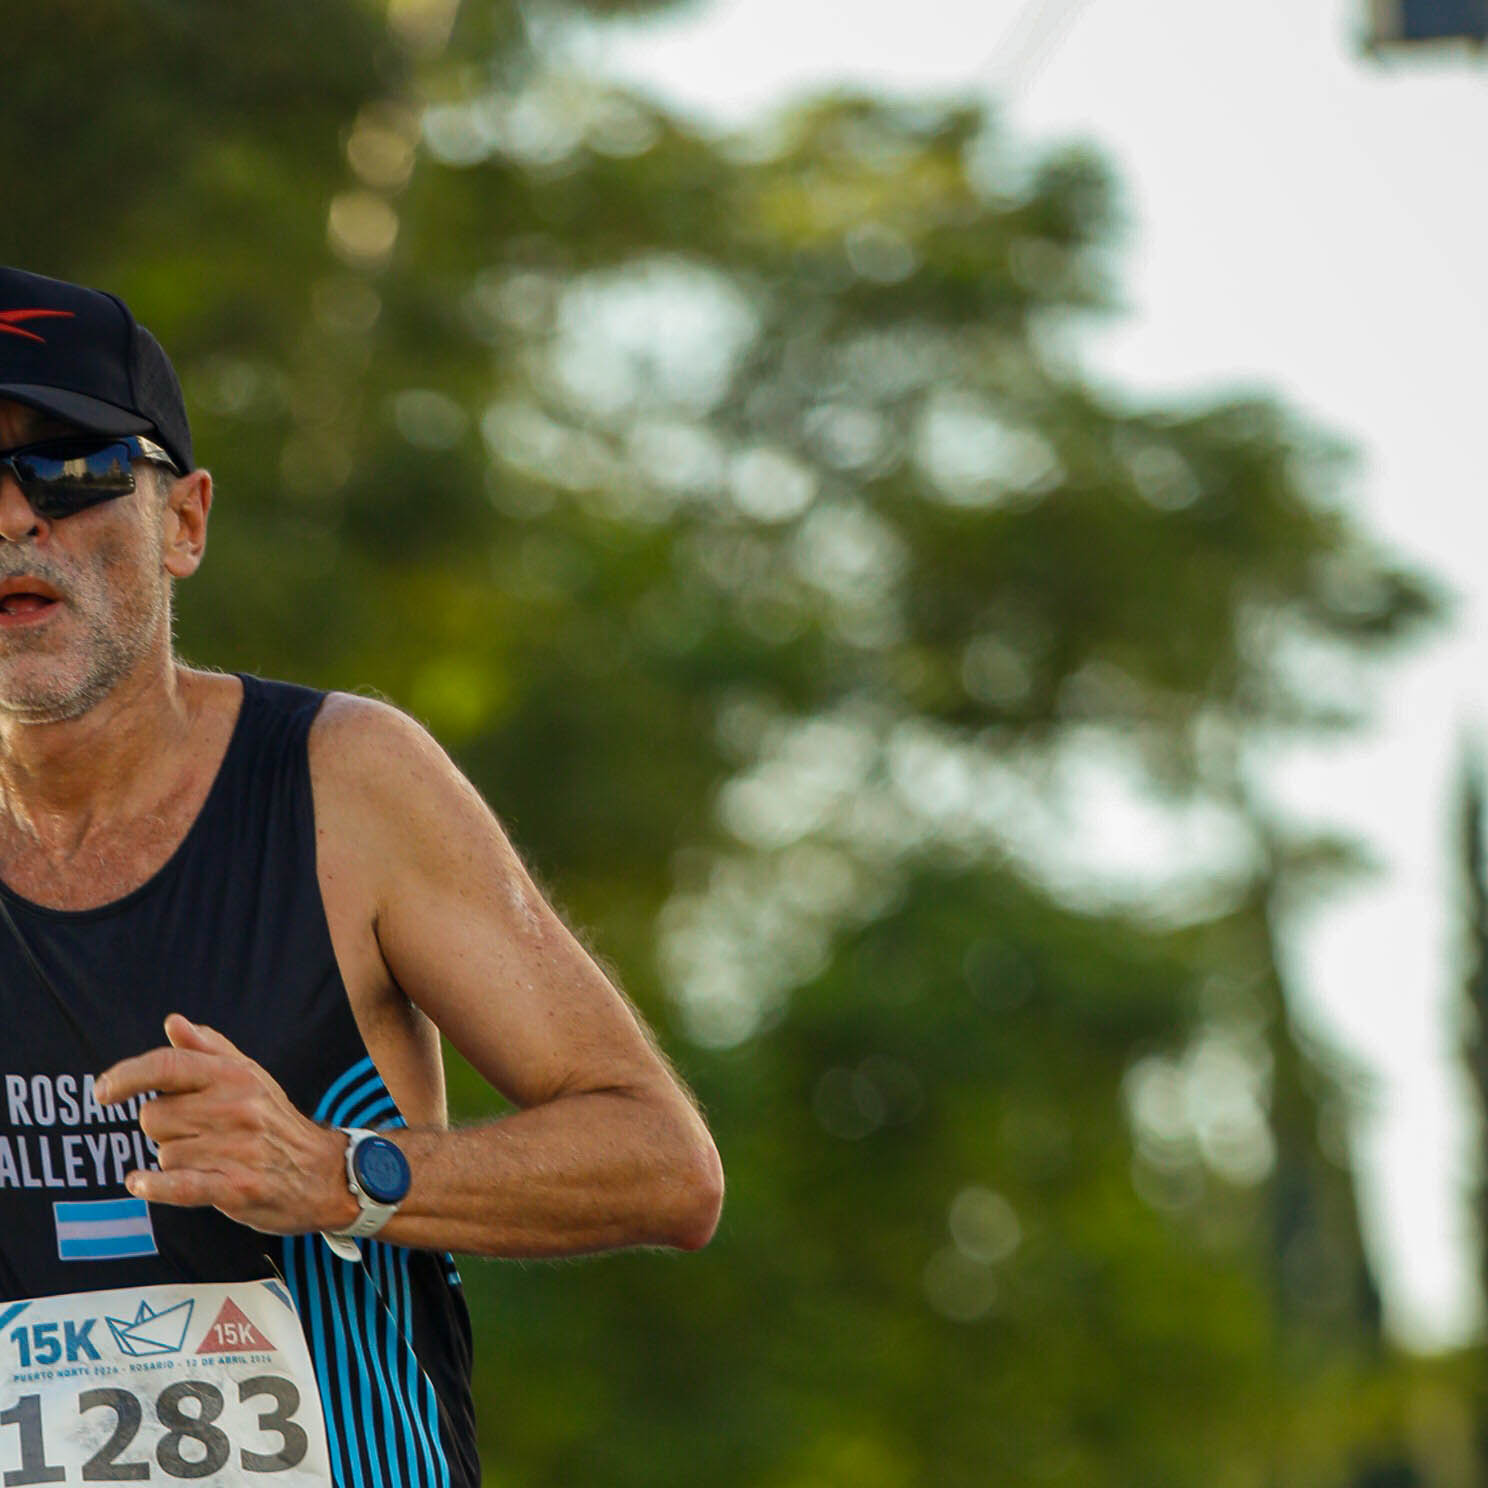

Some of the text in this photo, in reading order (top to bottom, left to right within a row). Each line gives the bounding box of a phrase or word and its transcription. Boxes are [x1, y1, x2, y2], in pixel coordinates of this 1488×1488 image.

[10, 1318, 102, 1368] 15K
[214, 1321, 257, 1346] 15K
[12, 1370, 54, 1383] PUERTO
[56, 1366, 90, 1377] NORTE
[128, 1359, 175, 1372] ROSARIO
[201, 1357, 215, 1367] DE
[218, 1355, 249, 1365] ABRIL
[0, 1375, 309, 1488] 1283
